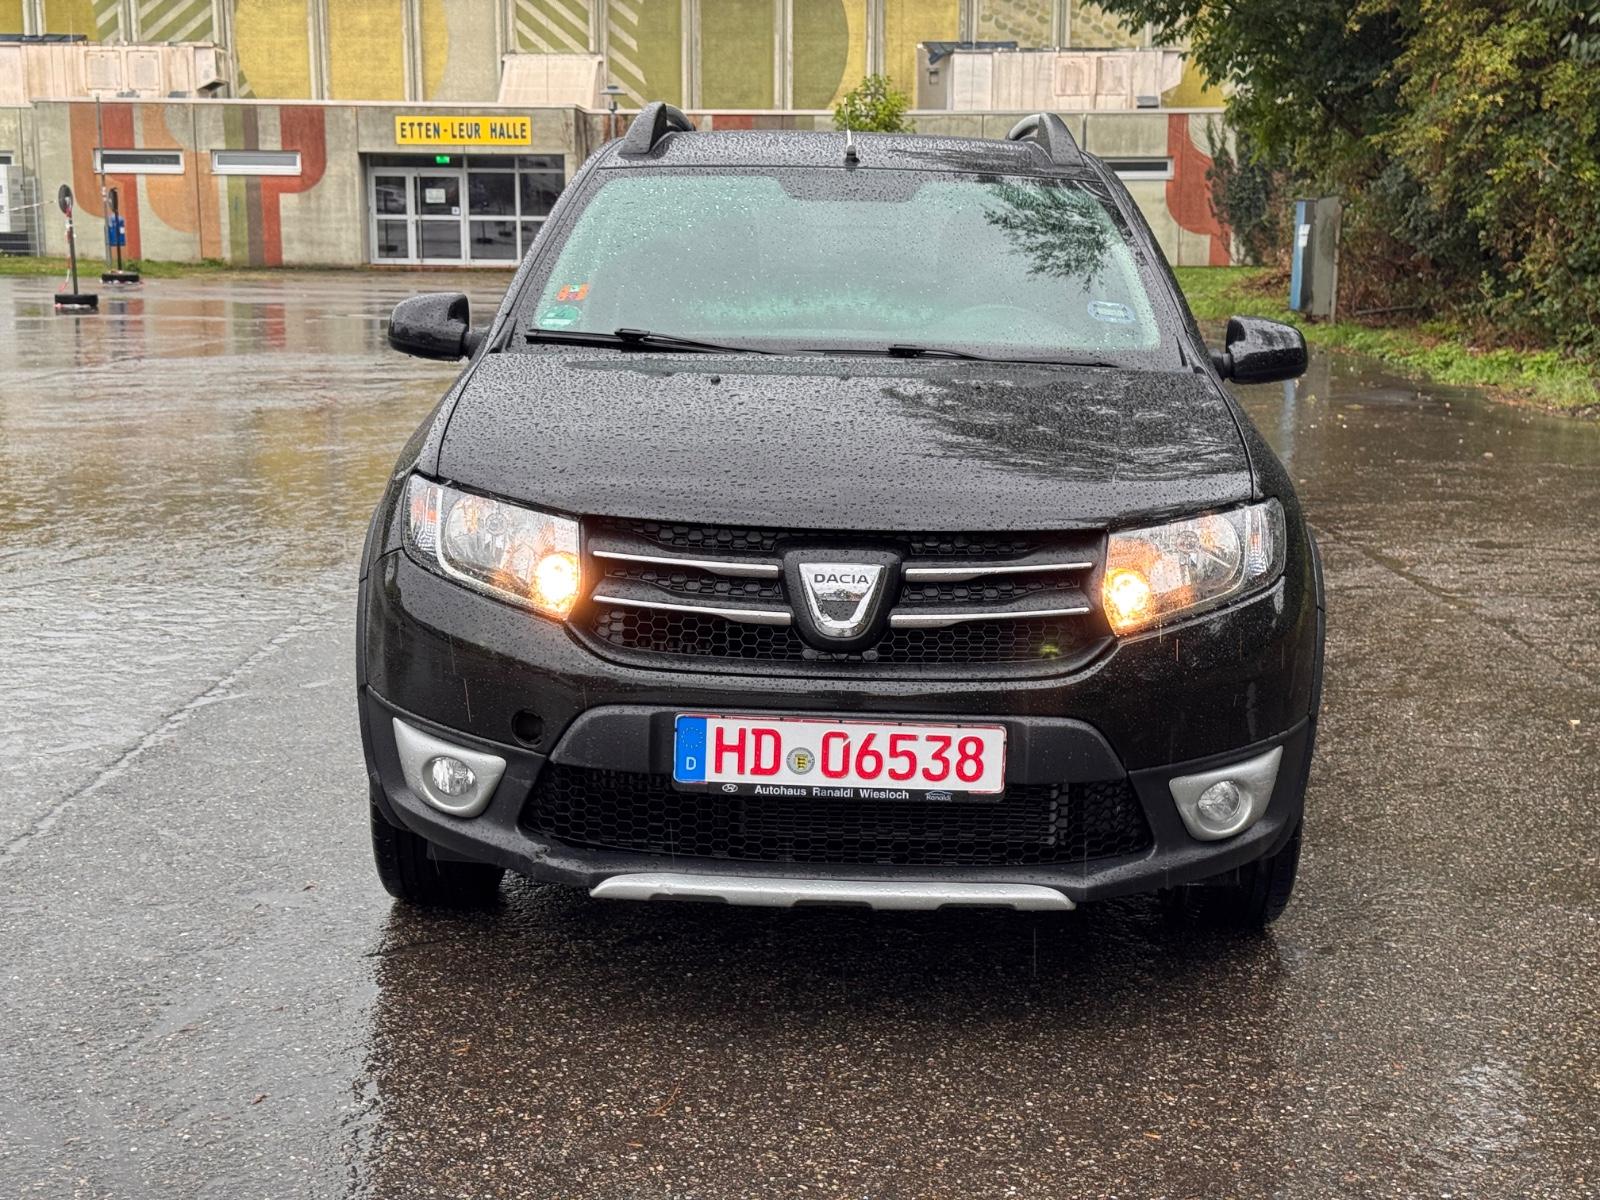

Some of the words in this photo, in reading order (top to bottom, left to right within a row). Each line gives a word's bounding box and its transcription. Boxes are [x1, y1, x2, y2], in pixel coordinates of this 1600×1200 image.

[400, 122, 481, 139] ETTEN-LEUR
[490, 122, 527, 139] HALLE
[814, 573, 869, 584] DACIA
[685, 756, 697, 771] D
[714, 726, 782, 776] HD
[820, 731, 985, 782] 06538
[754, 785, 807, 796] Autohaus
[812, 787, 854, 798] Ranaldi
[859, 789, 910, 799] Wiesloch
